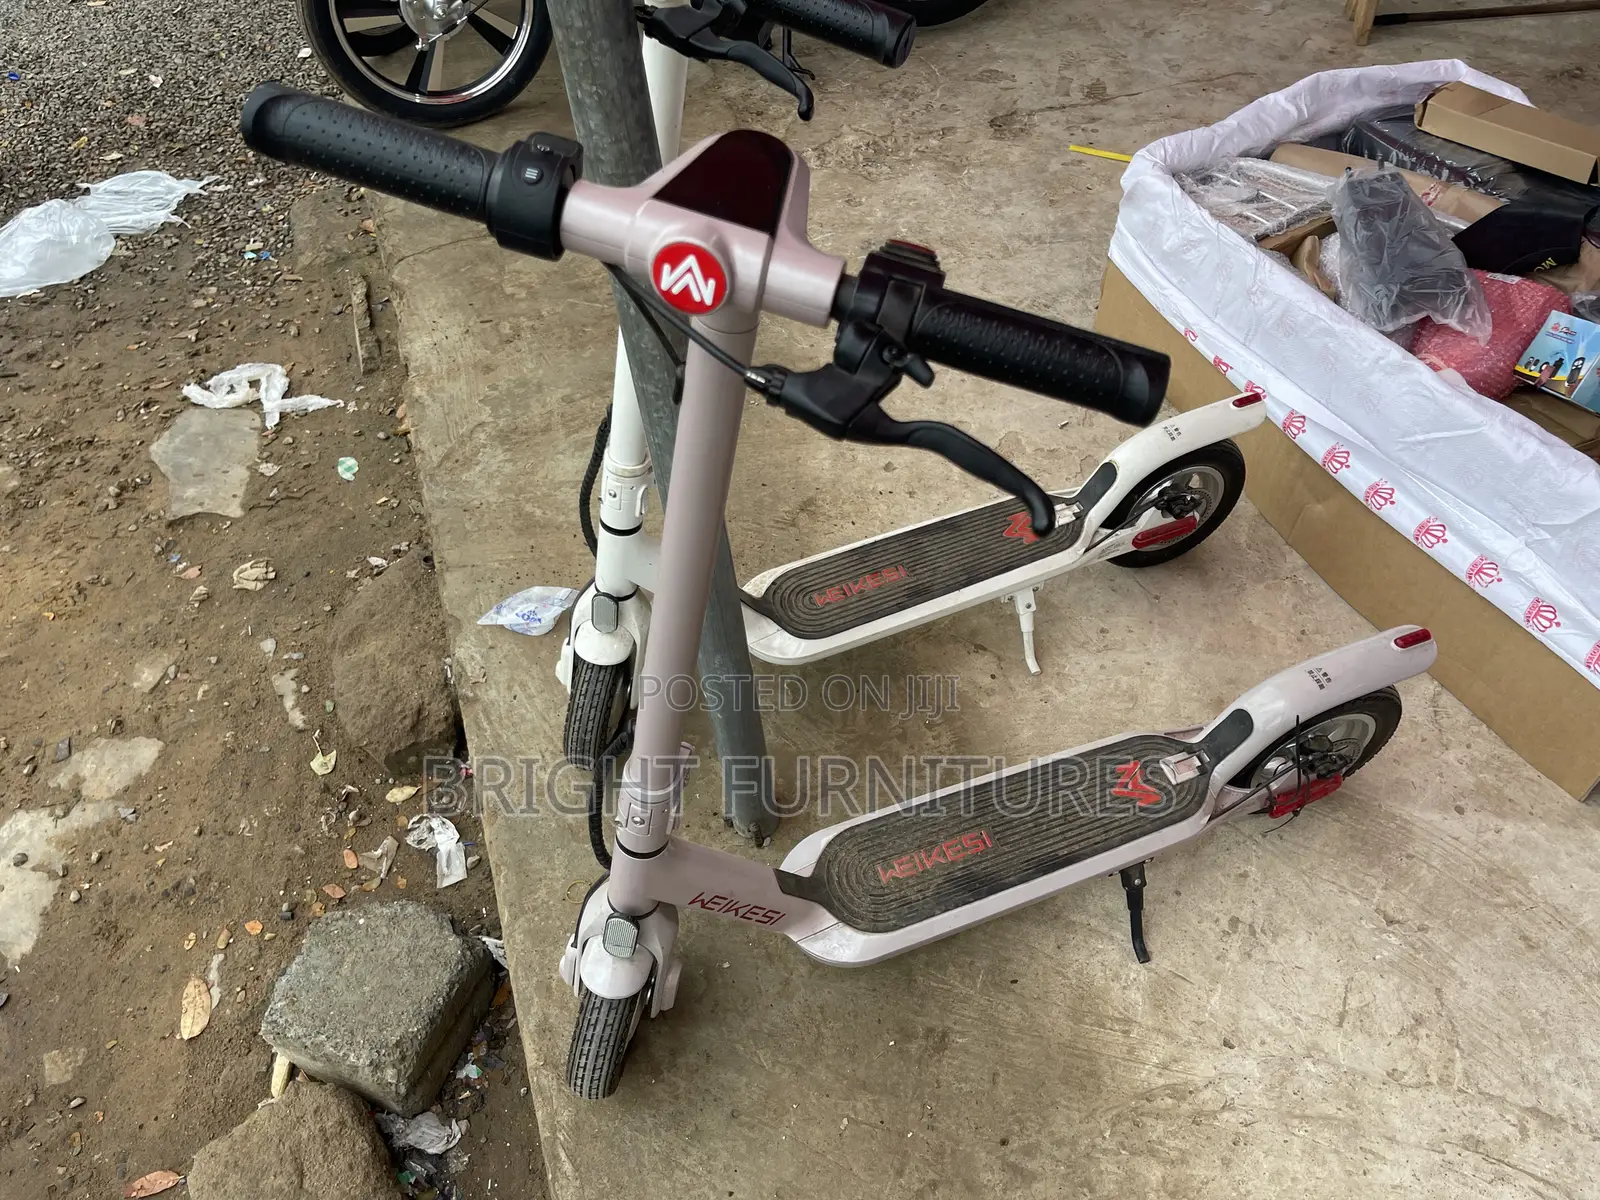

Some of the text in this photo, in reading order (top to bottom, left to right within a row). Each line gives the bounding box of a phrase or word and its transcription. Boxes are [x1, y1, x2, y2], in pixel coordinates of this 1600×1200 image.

[813, 565, 907, 607] WEIKESI
[876, 829, 993, 884] WEIKESI
[687, 891, 787, 926] WEIKESI
